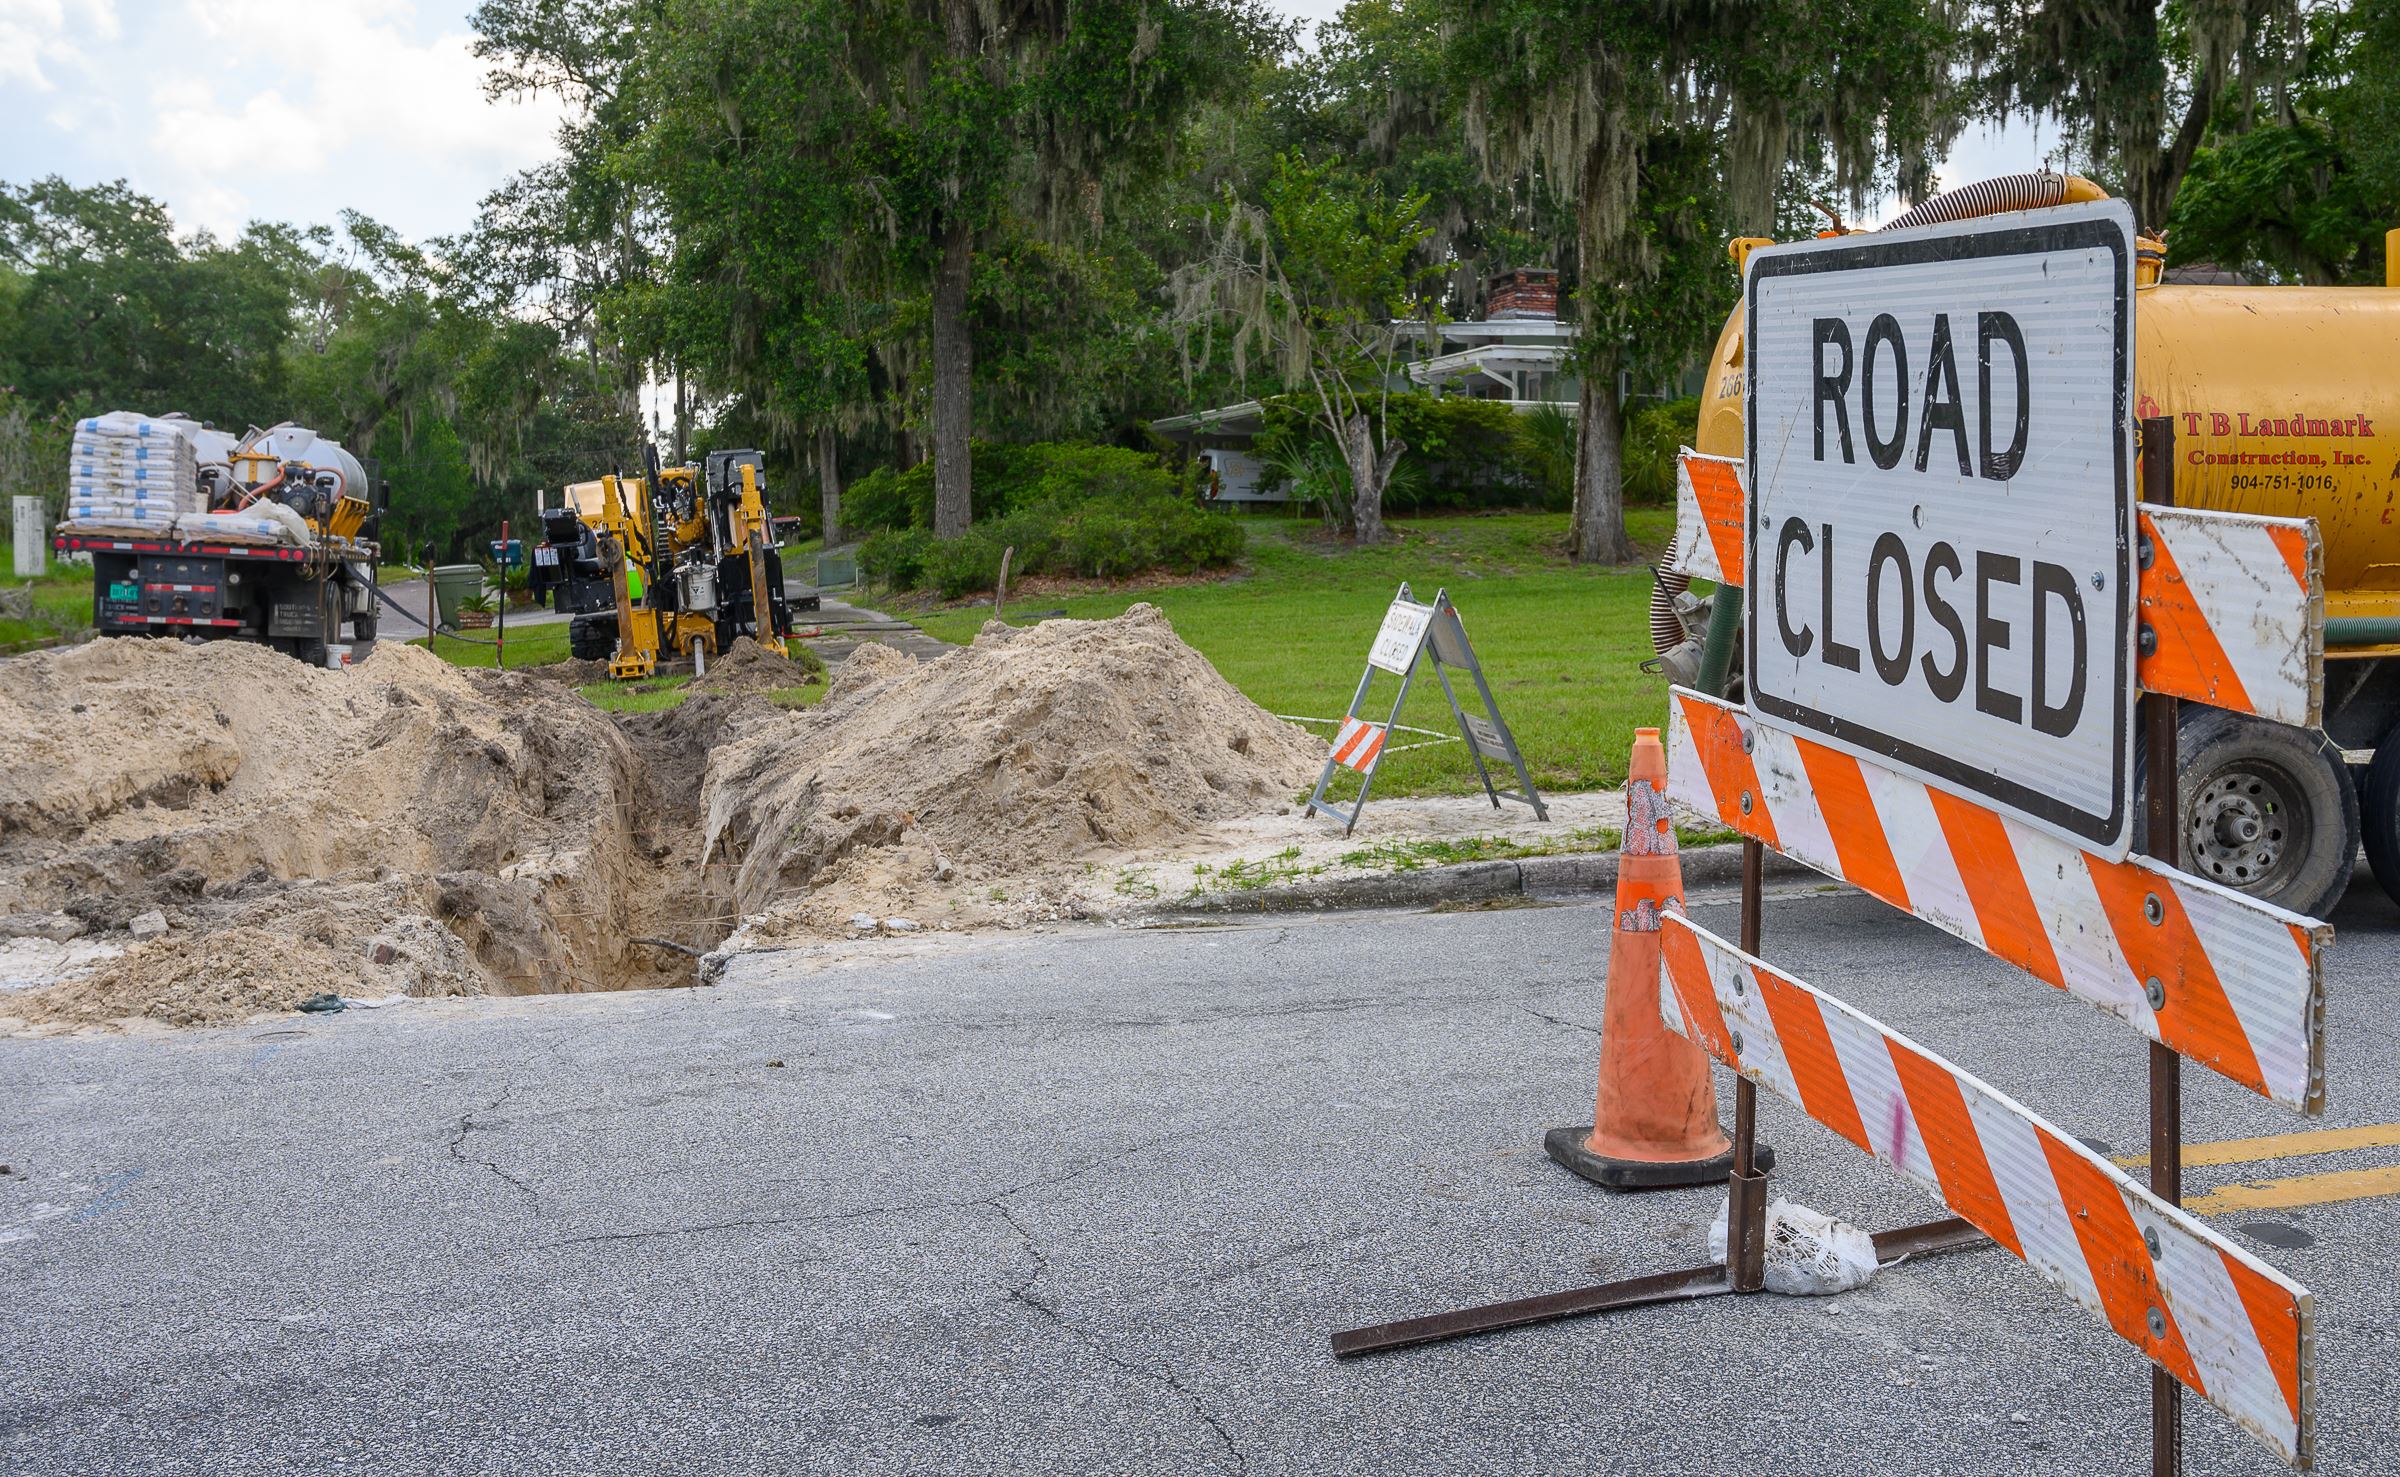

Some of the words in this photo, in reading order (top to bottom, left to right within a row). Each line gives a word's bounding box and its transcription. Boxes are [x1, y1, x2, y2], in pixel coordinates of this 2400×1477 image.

[1719, 373, 1745, 400] 266
[1812, 310, 2030, 482] ROAD
[2182, 412, 2203, 437] T
[2209, 412, 2231, 437] B
[2237, 412, 2376, 438] Landmark
[2187, 449, 2328, 468] Construction,
[2332, 450, 2372, 466] Inc.
[1775, 515, 2088, 740] CLOSED
